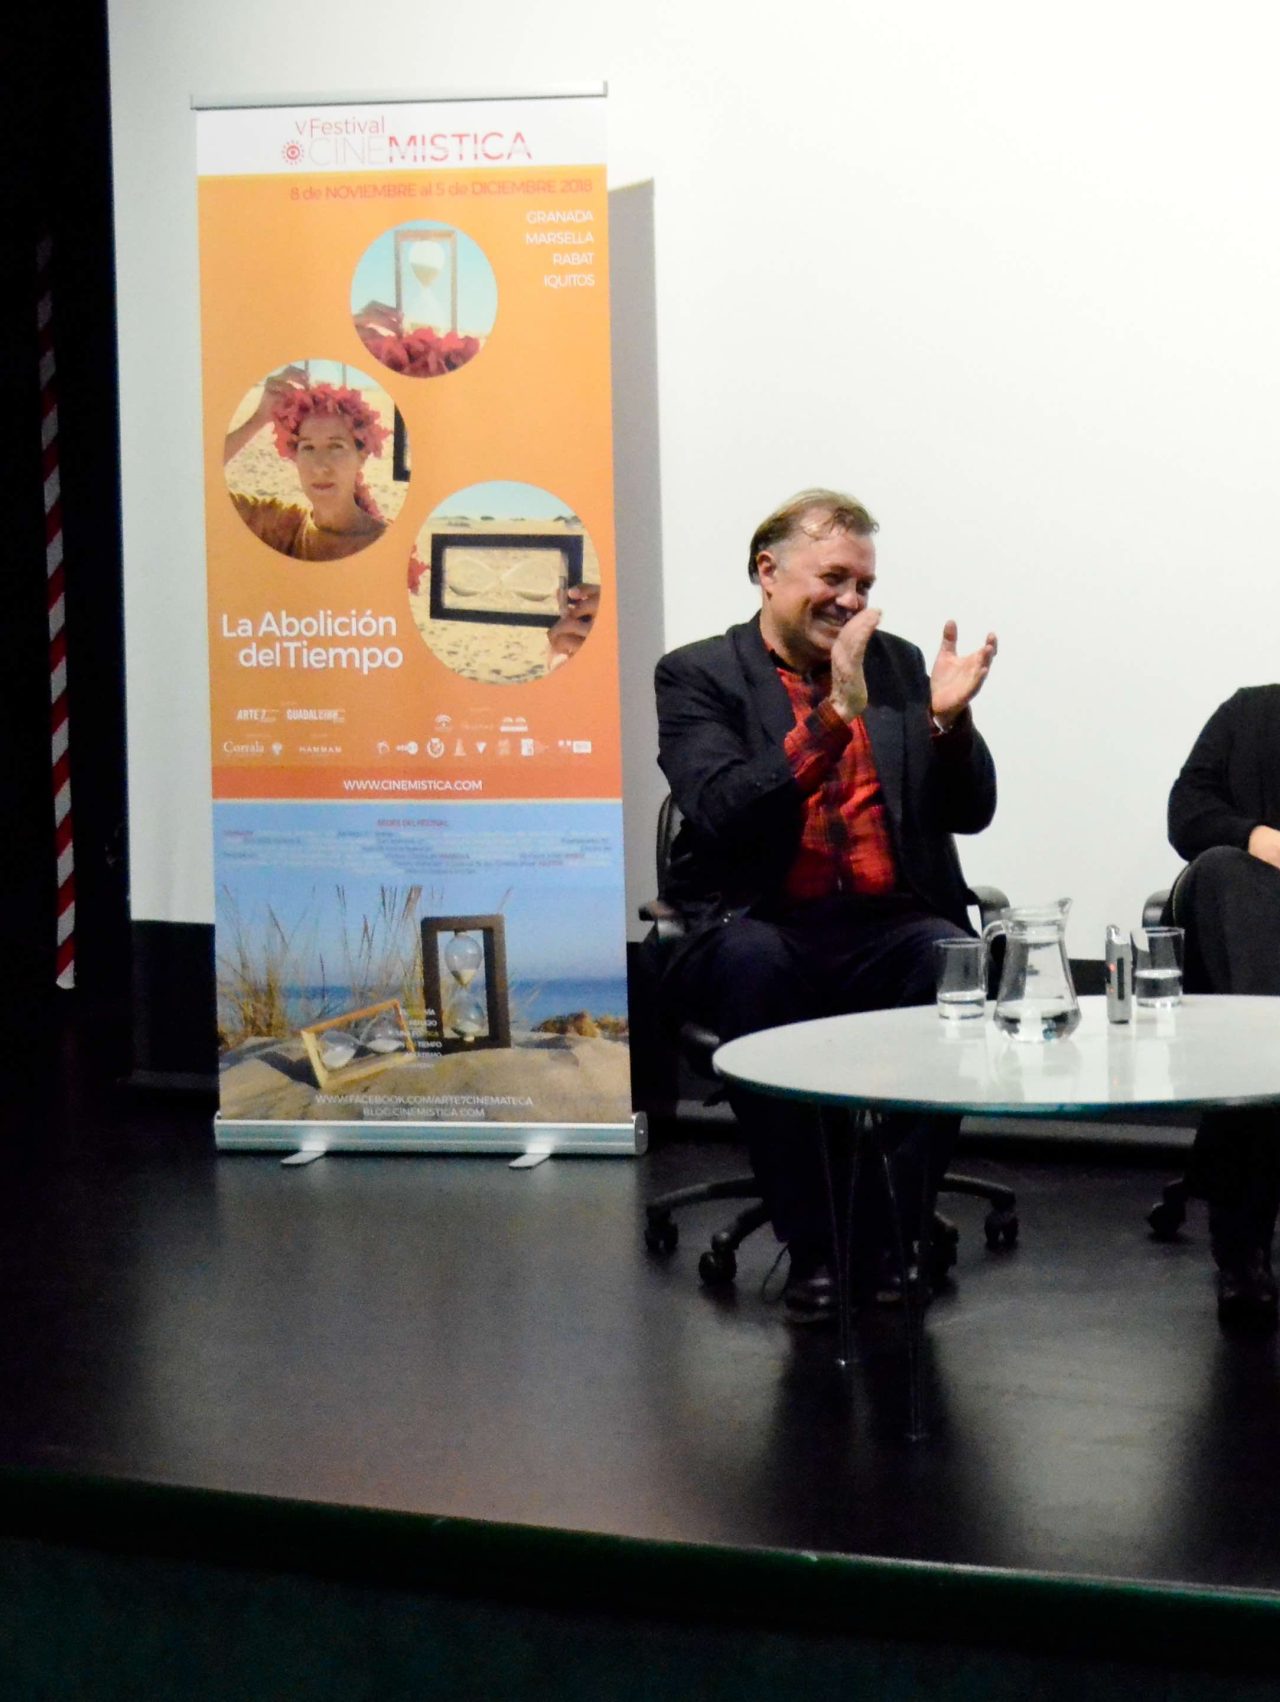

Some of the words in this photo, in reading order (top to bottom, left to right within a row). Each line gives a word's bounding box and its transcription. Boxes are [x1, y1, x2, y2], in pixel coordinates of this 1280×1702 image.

[309, 115, 386, 136] Festival
[308, 131, 533, 166] CINEMISTICA
[290, 188, 299, 200] 8
[302, 186, 322, 199] de
[325, 183, 417, 199] NOVIEMBRE
[420, 181, 434, 196] al
[435, 181, 446, 196] 5
[448, 180, 469, 196] de
[471, 178, 558, 196] DICIEMBRE
[560, 177, 593, 194] 2018
[526, 210, 594, 225] GRANADA
[525, 231, 594, 246] MARSELLA
[552, 252, 594, 266] RABAT
[544, 274, 595, 289] IQUITOS
[222, 613, 253, 637] La
[258, 609, 397, 637] Abolición
[239, 643, 281, 668] del
[283, 640, 404, 675] Tiempo
[343, 779, 483, 792] WWW.CINEMISTICA.COM
